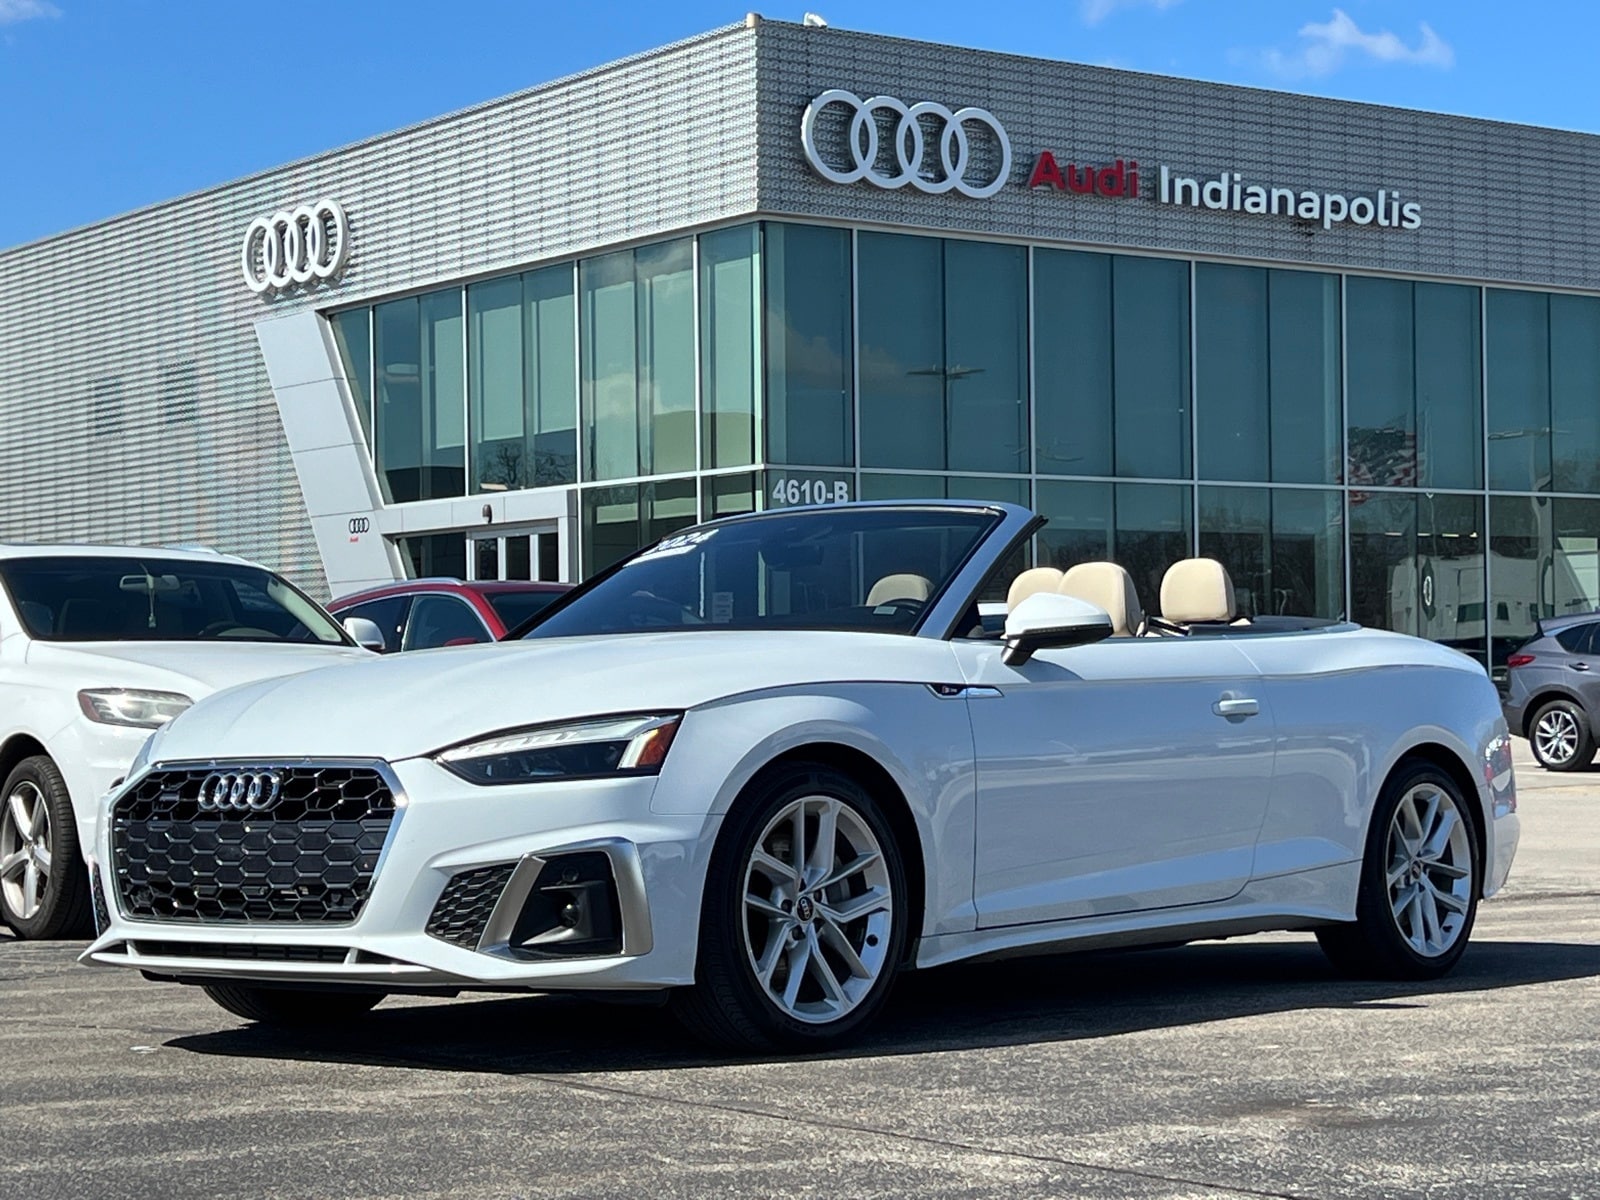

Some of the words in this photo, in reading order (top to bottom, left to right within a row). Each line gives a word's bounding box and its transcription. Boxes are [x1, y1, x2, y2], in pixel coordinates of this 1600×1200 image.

[1029, 151, 1138, 198] Audi
[1160, 165, 1422, 229] Indianapolis
[772, 479, 849, 504] 4610-B
